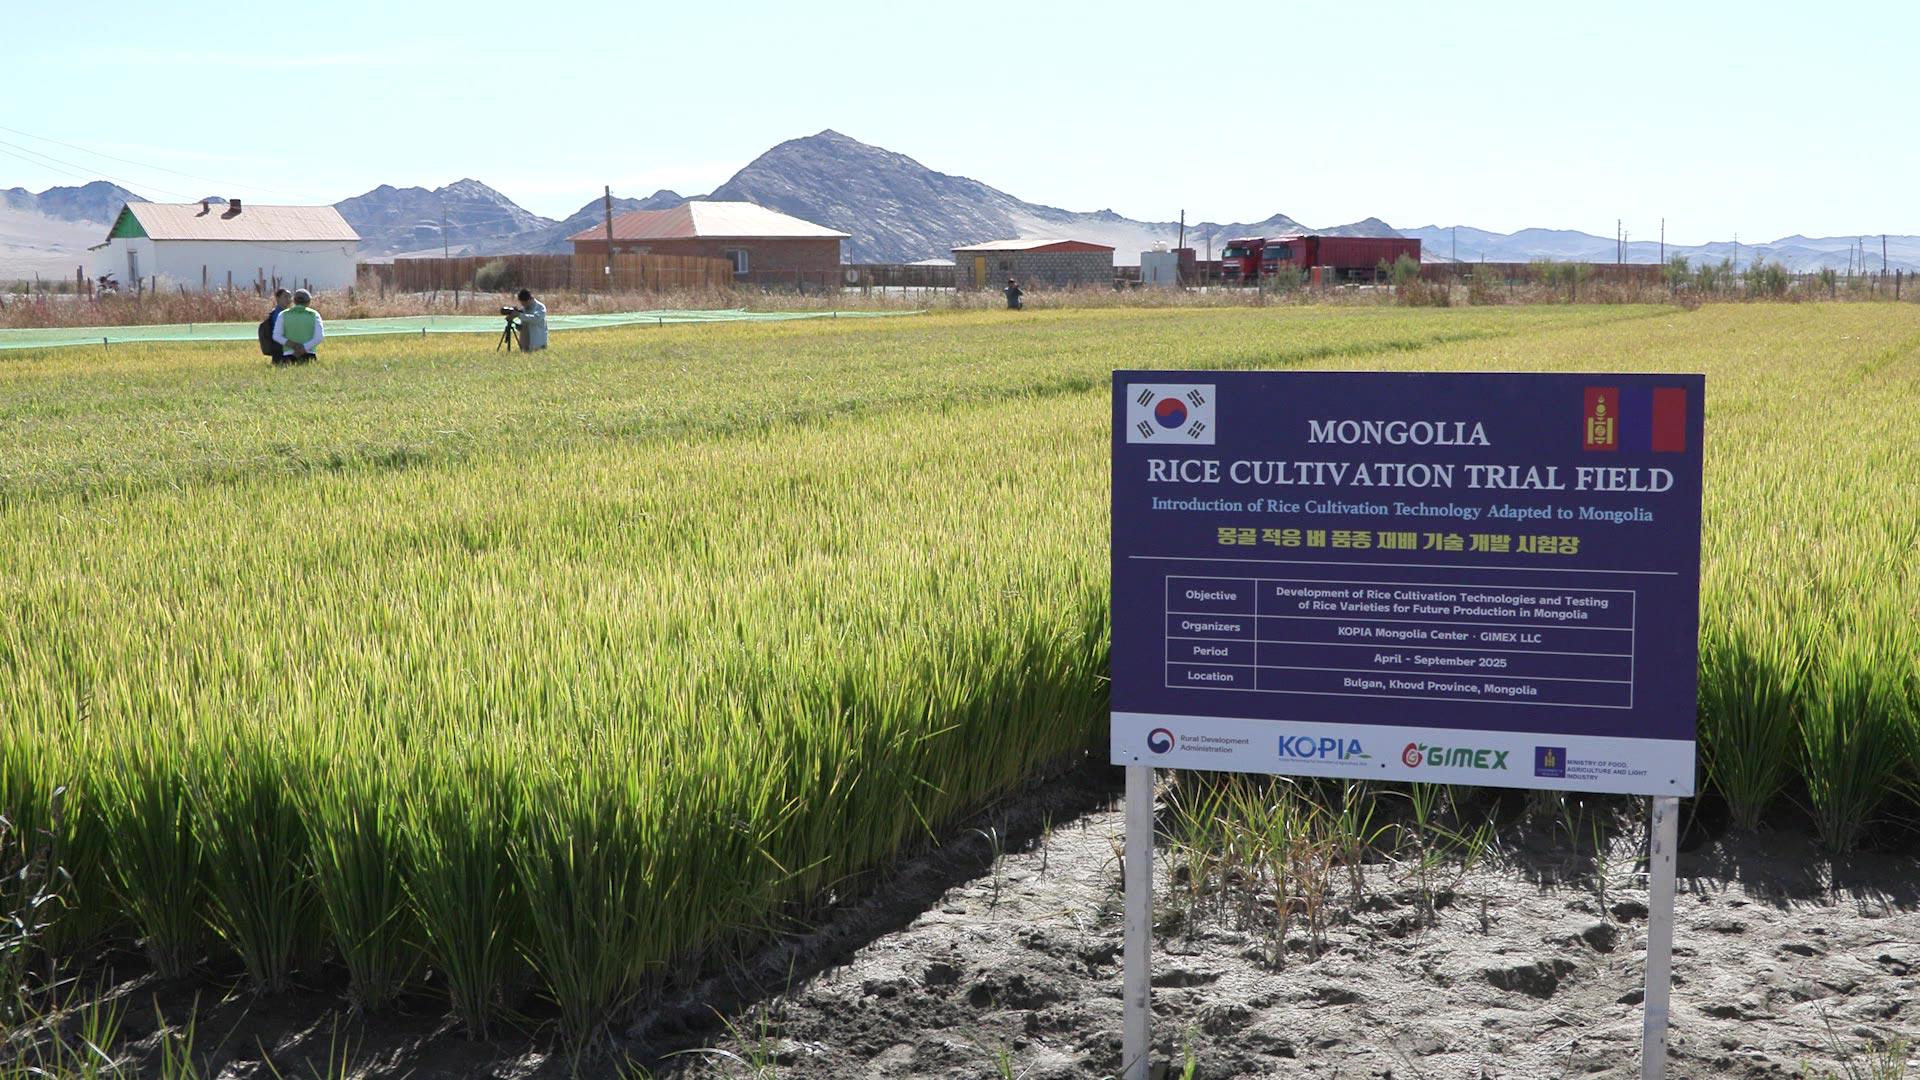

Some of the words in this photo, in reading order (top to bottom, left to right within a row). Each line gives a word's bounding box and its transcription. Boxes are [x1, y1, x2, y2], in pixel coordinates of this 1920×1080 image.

[1308, 420, 1490, 445] MONGOLIA
[1148, 459, 1220, 483] RICE
[1230, 461, 1454, 488] CULTIVATION
[1464, 465, 1565, 490] TRIAL
[1575, 467, 1673, 492] FIELD
[1152, 497, 1242, 511] Introduction
[1248, 498, 1264, 512] of
[1267, 500, 1300, 512] Rice
[1305, 500, 1388, 514] Cultivation
[1393, 502, 1481, 520] Technology
[1488, 504, 1551, 521] Adapted
[1558, 508, 1573, 519] to
[1579, 507, 1653, 524] Mongolia
[1218, 528, 1257, 545] 몽골
[1262, 529, 1301, 546] 적응
[1307, 530, 1325, 547] 벼
[1331, 531, 1371, 548] 품종
[1377, 532, 1417, 549] 재배
[1423, 533, 1464, 551] 기술
[1469, 534, 1511, 552] 개발
[1516, 536, 1580, 554] 시험장
[1186, 590, 1236, 601] Objective
[1277, 587, 1349, 601] Development
[1352, 590, 1363, 599] of
[1367, 590, 1391, 599] Rice
[1394, 590, 1456, 602] Cultivation
[1459, 592, 1536, 607] Technologies
[1539, 596, 1561, 605] and
[1565, 596, 1609, 609] Testing
[1299, 601, 1310, 609] of
[1313, 601, 1336, 610] Rice
[1340, 602, 1390, 612] Varieties
[1393, 604, 1410, 612] for
[1413, 604, 1450, 614] Future
[1454, 606, 1516, 616] Production
[1520, 608, 1530, 617] in
[1534, 609, 1587, 620] Mongolia
[1182, 621, 1241, 634] Organizers
[1339, 627, 1372, 636] KOPIA
[1376, 628, 1428, 641] Mongolia
[1431, 630, 1469, 640] Center
[1480, 632, 1517, 642] GIMEX
[1521, 634, 1541, 643] LLC
[1194, 647, 1228, 656] Period
[1374, 654, 1401, 664] April
[1414, 655, 1476, 668] September
[1479, 658, 1507, 667] 2025
[1188, 671, 1233, 681] Location
[1344, 677, 1386, 691] Bulgan,
[1390, 680, 1424, 689] Khovd
[1428, 681, 1480, 694] Province,
[1484, 684, 1537, 696] Mongolia
[1180, 744, 1232, 753] Administration
[1201, 736, 1249, 746] Development
[1278, 736, 1363, 760] KOPIA
[1427, 747, 1510, 770] GIMEX
